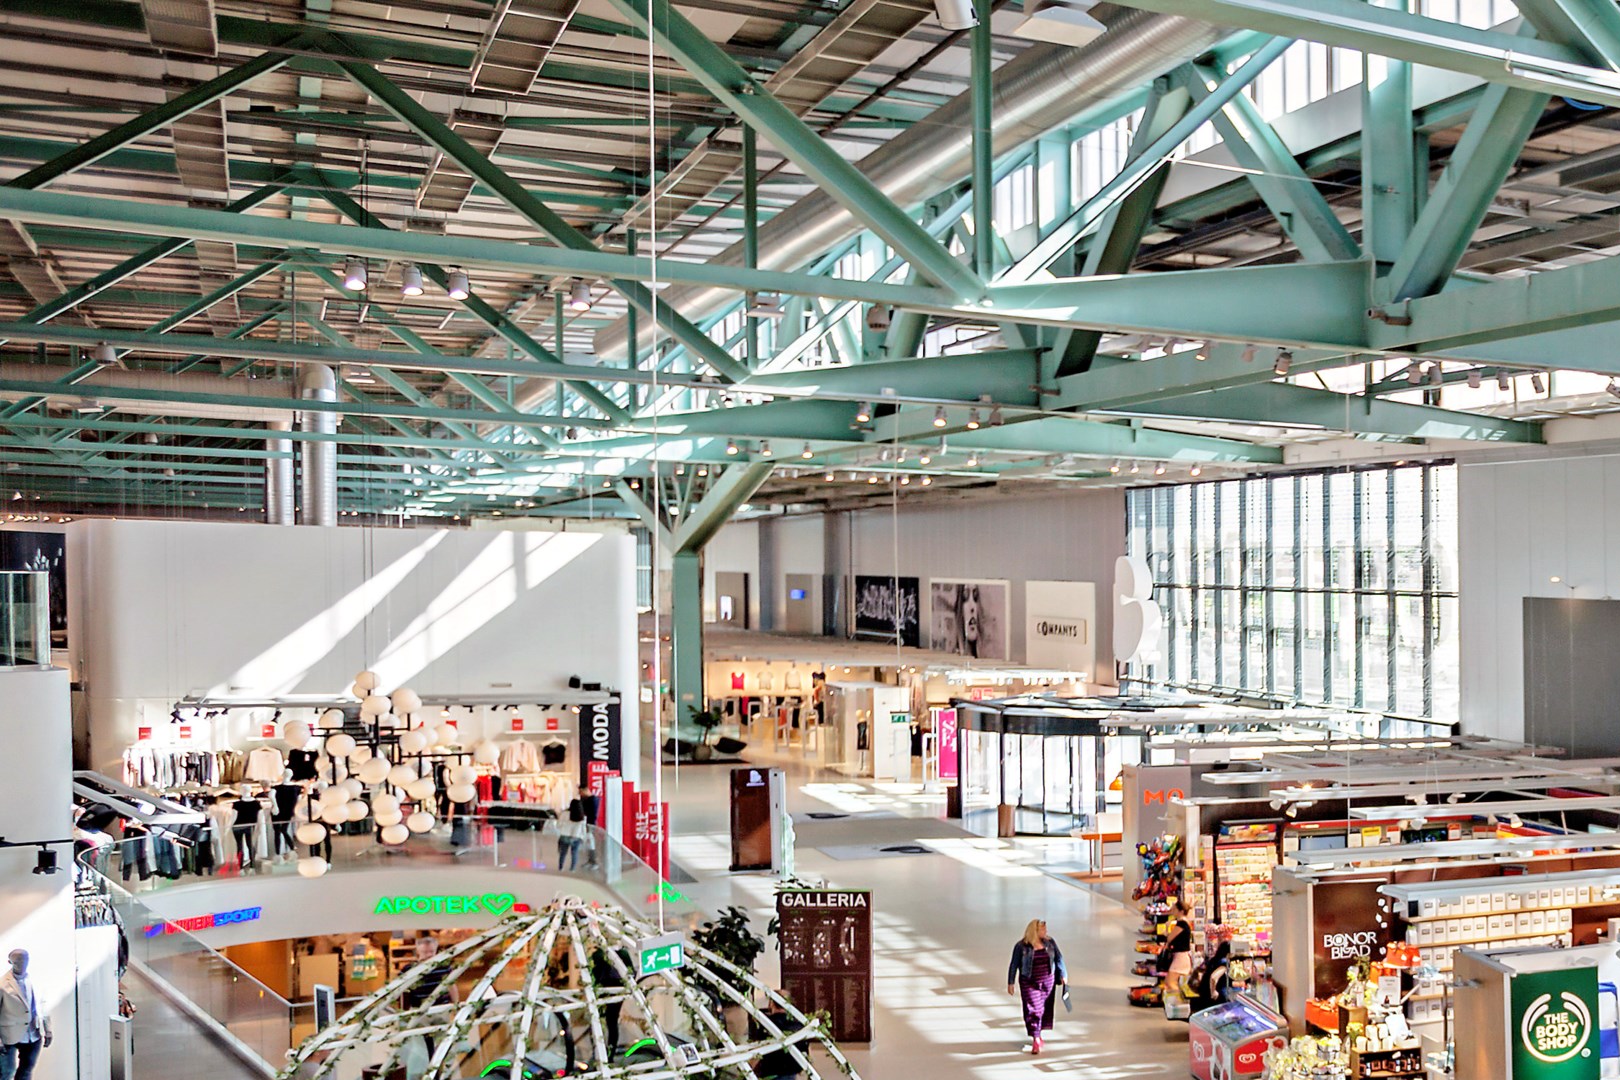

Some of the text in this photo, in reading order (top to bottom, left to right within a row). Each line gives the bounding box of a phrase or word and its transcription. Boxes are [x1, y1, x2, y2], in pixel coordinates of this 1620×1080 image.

[1036, 620, 1078, 638] COMPANYS
[592, 702, 610, 760] MODA
[635, 811, 649, 840] SALE
[650, 804, 665, 844] SALE
[374, 894, 480, 915] APOTEK
[781, 893, 867, 908] GALLERIA
[1323, 931, 1378, 949] BONOR
[1331, 944, 1372, 960] BLAD
[1543, 1012, 1569, 1024] THE
[1535, 1021, 1579, 1039] BODY
[1537, 1033, 1578, 1051] SHOP
